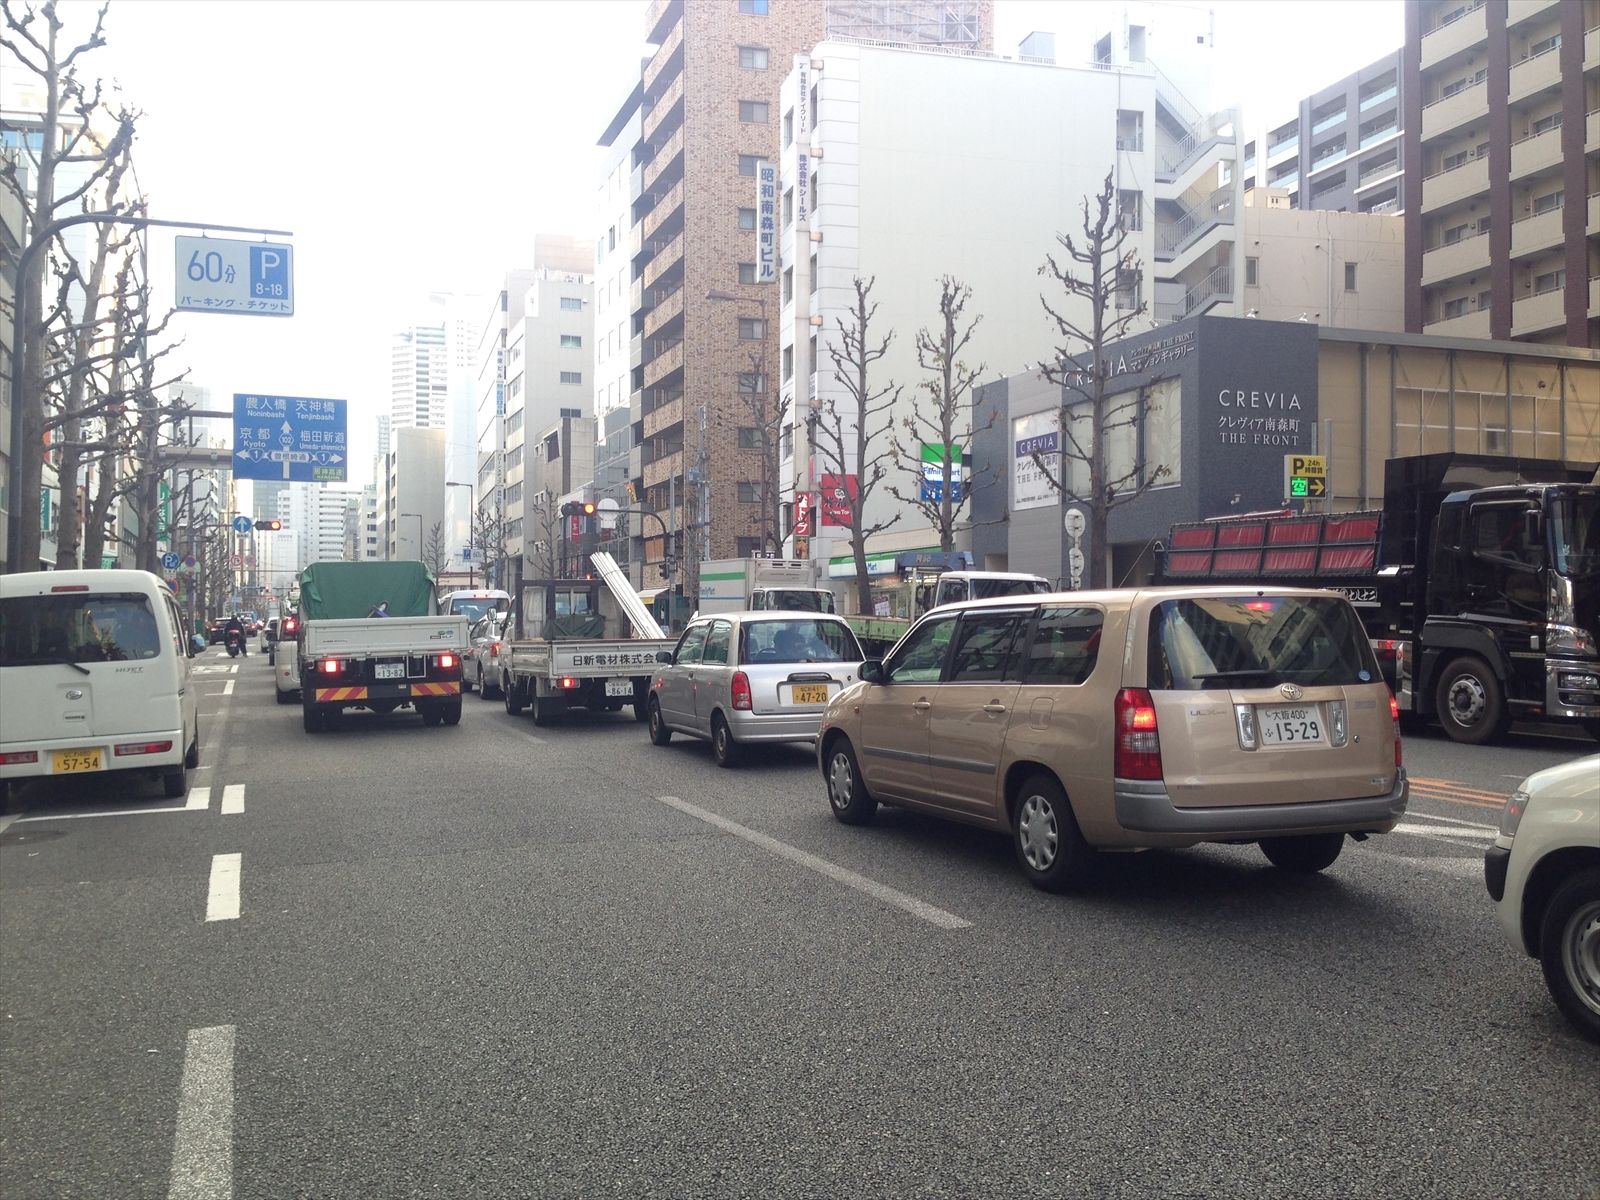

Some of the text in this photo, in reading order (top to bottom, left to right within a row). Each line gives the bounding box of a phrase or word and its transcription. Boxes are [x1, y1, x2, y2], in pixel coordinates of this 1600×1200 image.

[760, 167, 775, 278] 昭和南森町ビル
[261, 250, 281, 281] P
[255, 283, 283, 296] 8-18
[295, 399, 336, 413] 天神橋
[1219, 389, 1301, 410] CREVIA
[1219, 416, 1300, 432] クレヴィア南森町
[240, 427, 345, 444] 京都 梅田新道
[1220, 432, 1299, 446] THE FRONT
[243, 440, 266, 448] Kyoto
[1293, 458, 1305, 475] P
[572, 653, 660, 666] 日新電材株式会
[1276, 721, 1320, 741] 15-29
[63, 756, 99, 771] 57-54
